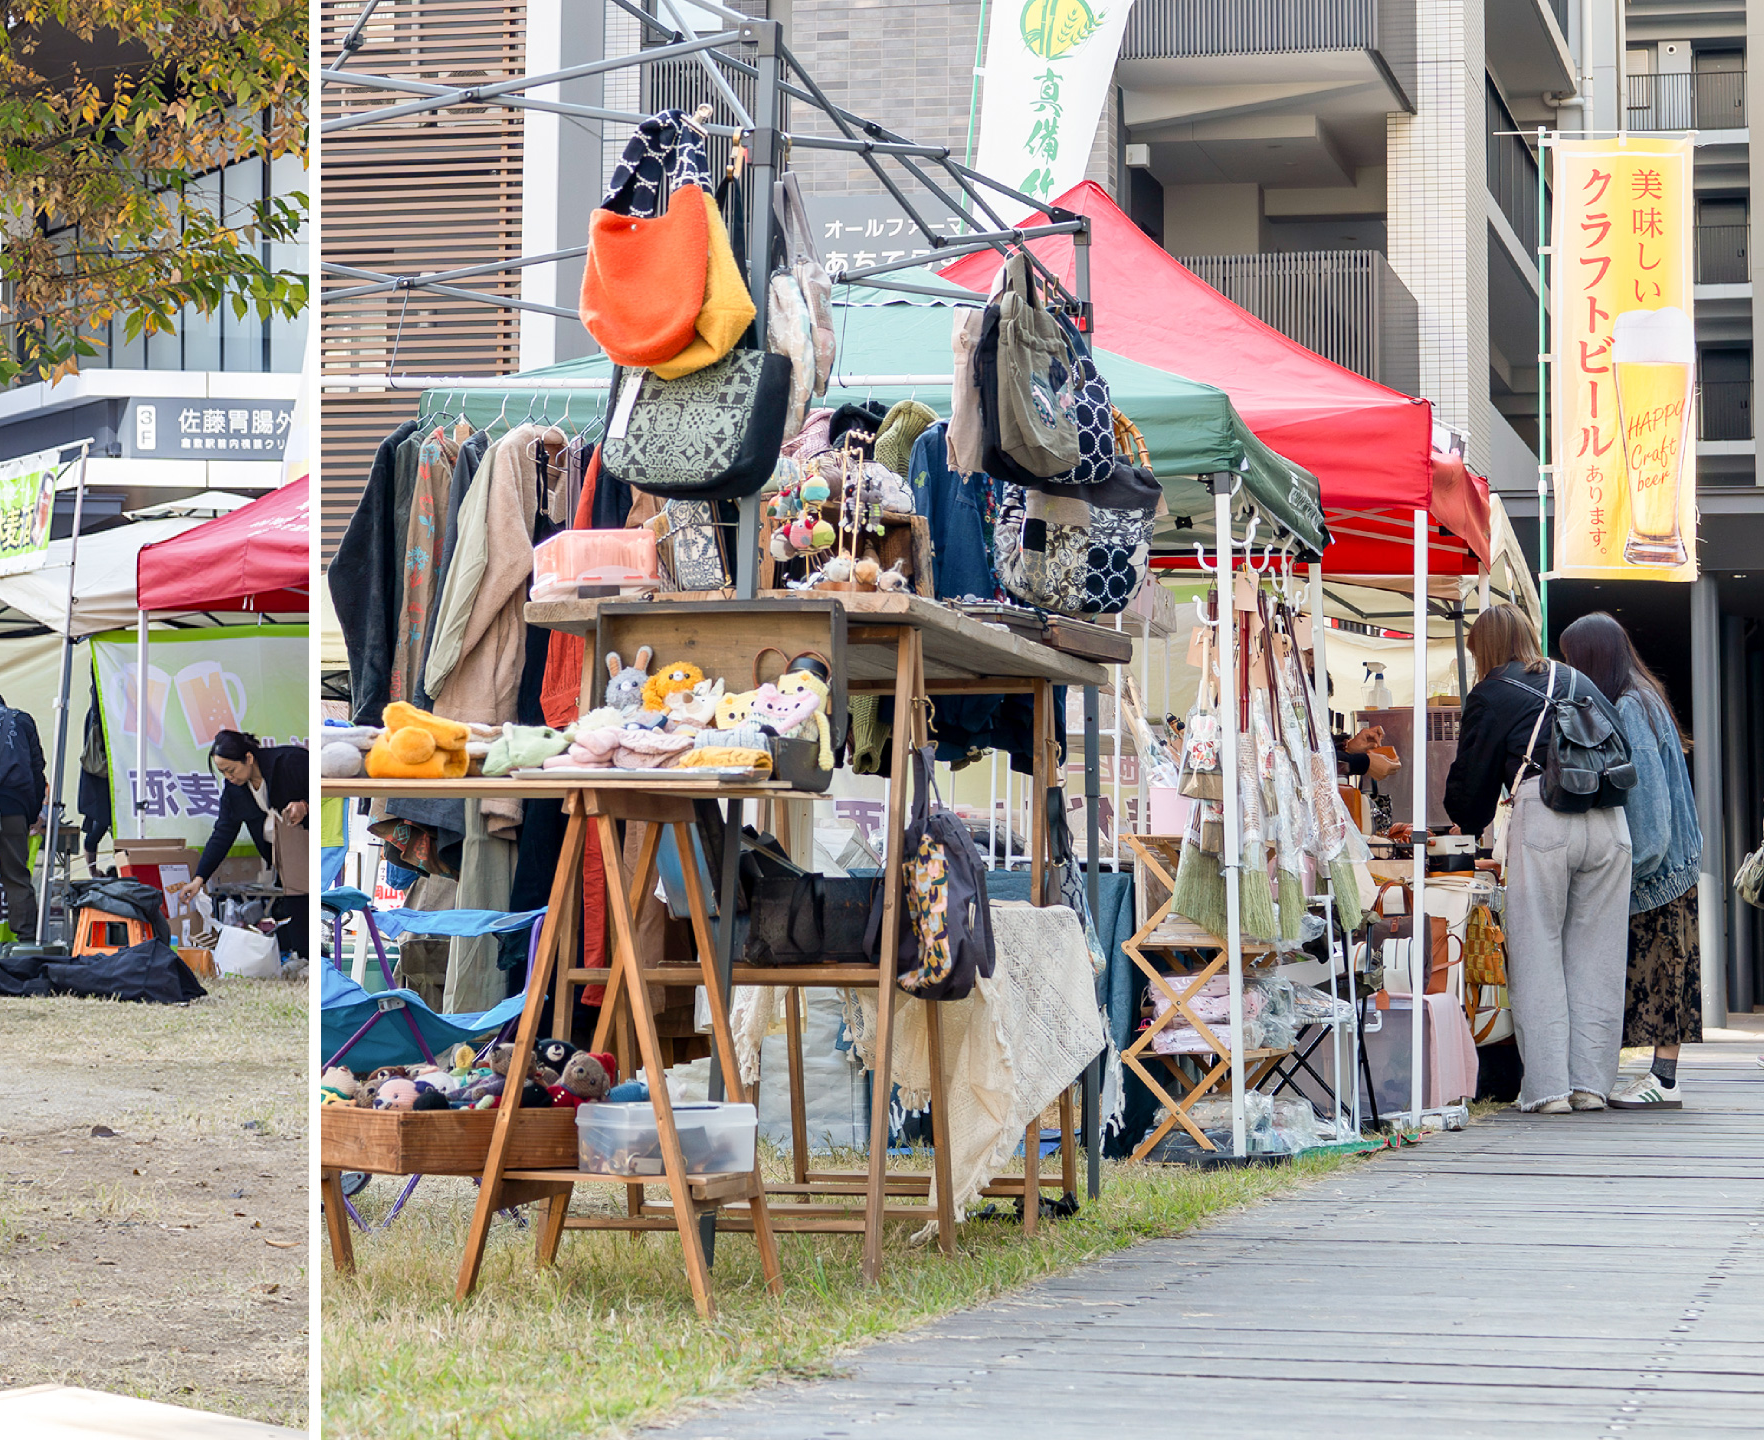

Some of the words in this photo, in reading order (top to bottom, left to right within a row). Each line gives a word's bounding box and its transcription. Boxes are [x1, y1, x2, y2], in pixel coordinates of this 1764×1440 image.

[1630, 168, 1664, 303] 美味しい
[1576, 168, 1616, 459] クラフトビール
[139, 409, 152, 448] 3F
[1628, 398, 1686, 441] HAPPY
[1631, 435, 1677, 480] Craft
[1637, 470, 1671, 492] beer
[1585, 464, 1609, 555] あります。
